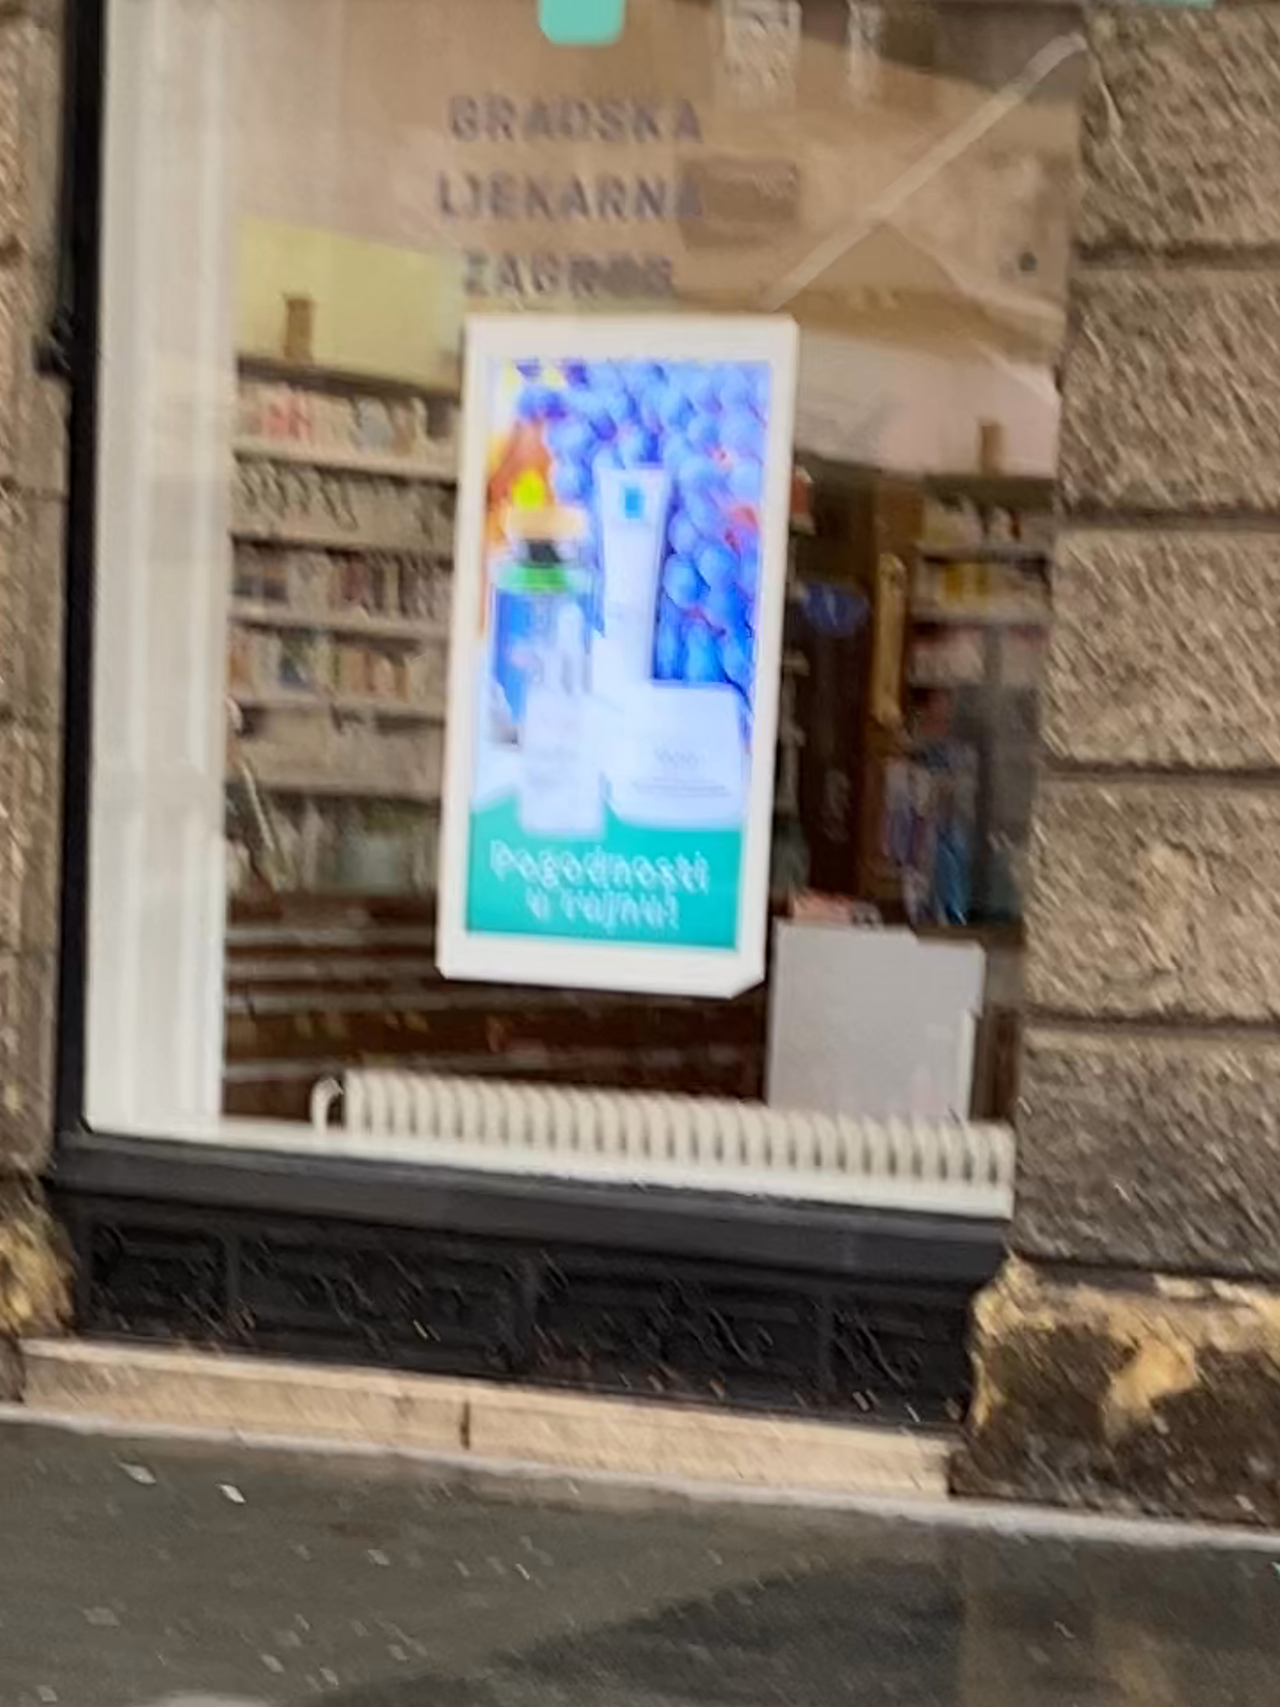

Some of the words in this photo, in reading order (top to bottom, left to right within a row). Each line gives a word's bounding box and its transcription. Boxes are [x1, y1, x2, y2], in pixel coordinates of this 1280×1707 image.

[451, 96, 704, 143] GRADSKA
[434, 167, 704, 223] LJEKARNA
[489, 840, 710, 895] Pogodnosti
